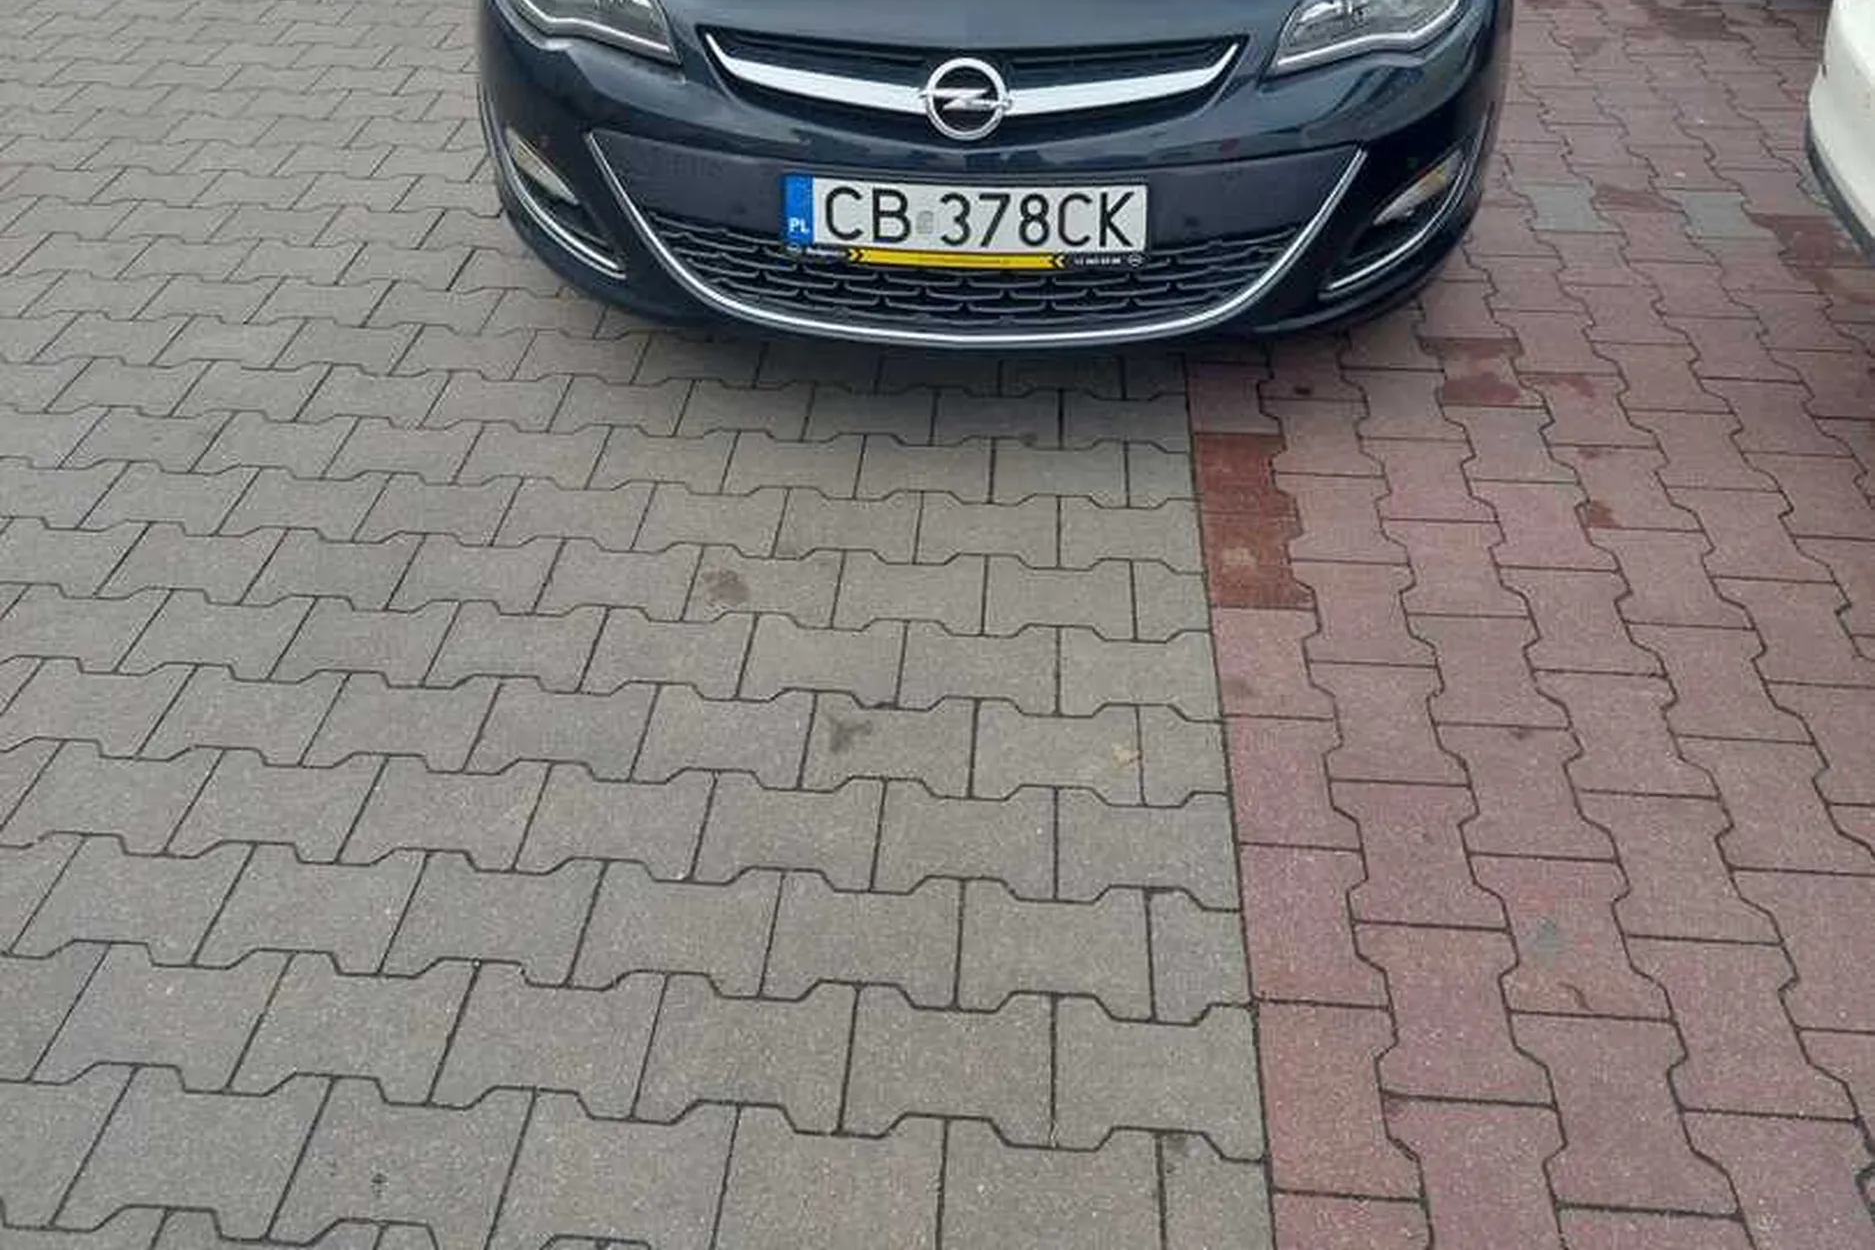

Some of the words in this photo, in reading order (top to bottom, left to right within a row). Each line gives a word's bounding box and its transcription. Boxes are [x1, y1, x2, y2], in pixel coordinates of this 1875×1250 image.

[788, 217, 810, 232] PL
[824, 185, 912, 243] CB
[939, 190, 1135, 248] 378CK
